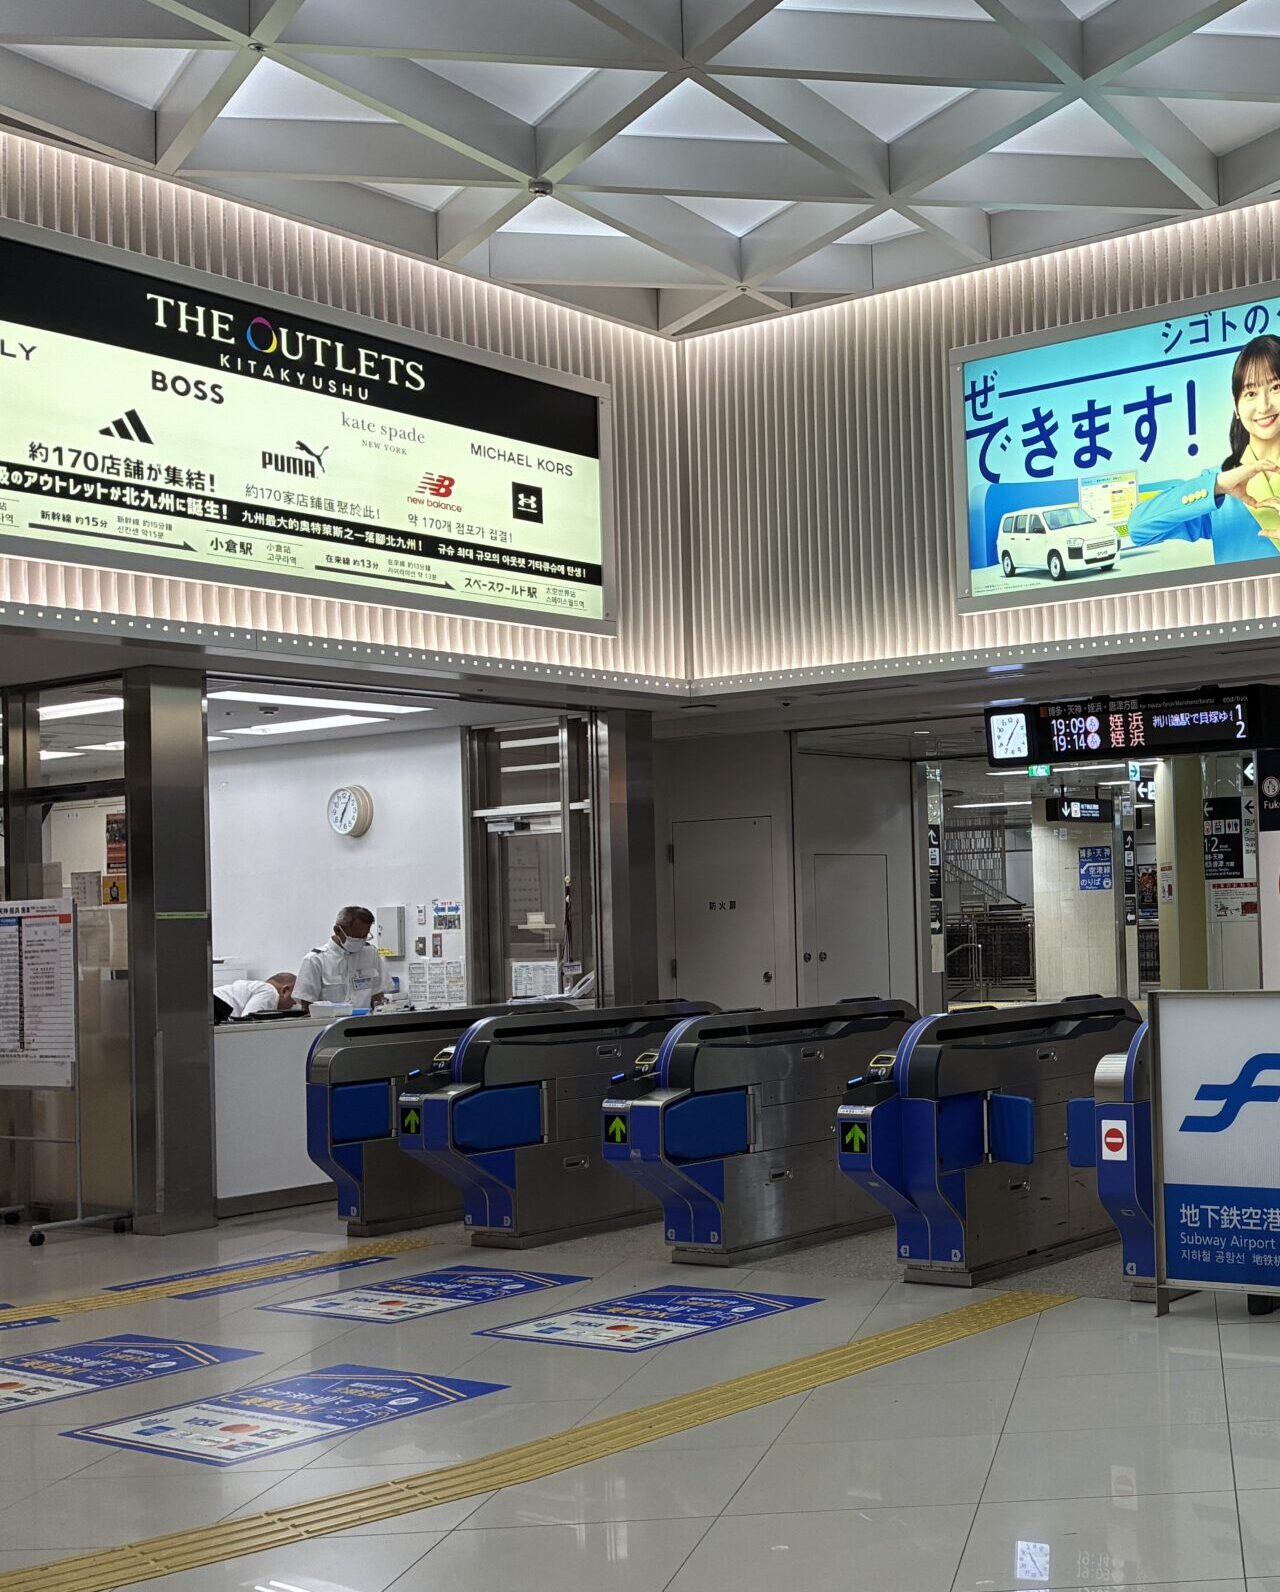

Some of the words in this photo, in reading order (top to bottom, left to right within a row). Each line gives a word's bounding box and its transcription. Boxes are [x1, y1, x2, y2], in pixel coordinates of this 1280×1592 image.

[146, 293, 236, 345] THE
[246, 316, 427, 391] OUTLETS
[151, 370, 225, 405] BOSS
[219, 353, 370, 401] KITAKYUSHU
[965, 370, 999, 422] ぜ
[341, 411, 376, 433] kate
[380, 423, 426, 445] spade
[965, 379, 1199, 485] できます!
[361, 439, 381, 450] NEW
[384, 443, 408, 456] YORK
[28, 441, 216, 493] 約170店舗が集結!
[262, 450, 317, 479] PUMA
[470, 443, 533, 468] MICHAEL
[537, 459, 574, 477] KORS
[407, 494, 425, 506] new
[426, 497, 463, 513] balance
[40, 510, 72, 524] 新幹線
[75, 514, 108, 529] 約15分
[408, 513, 418, 528] 약
[422, 516, 452, 533] 170개
[455, 522, 486, 539] 점포가
[489, 528, 513, 544] 집결!
[210, 537, 253, 556] 小倉駅
[437, 543, 455, 557] 규슈
[457, 546, 474, 560] 최대
[475, 550, 500, 564] 규모의
[464, 577, 538, 600] スペースワールド駅
[1235, 704, 1243, 721] 1
[1051, 717, 1086, 736] 19:09
[1236, 721, 1247, 739] 2
[1053, 733, 1087, 752] 19:14
[1180, 1231, 1228, 1249] Subway
[1231, 1234, 1277, 1251] Airport
[1181, 1250, 1211, 1264] 지하철
[1215, 1251, 1246, 1265] 공항선
